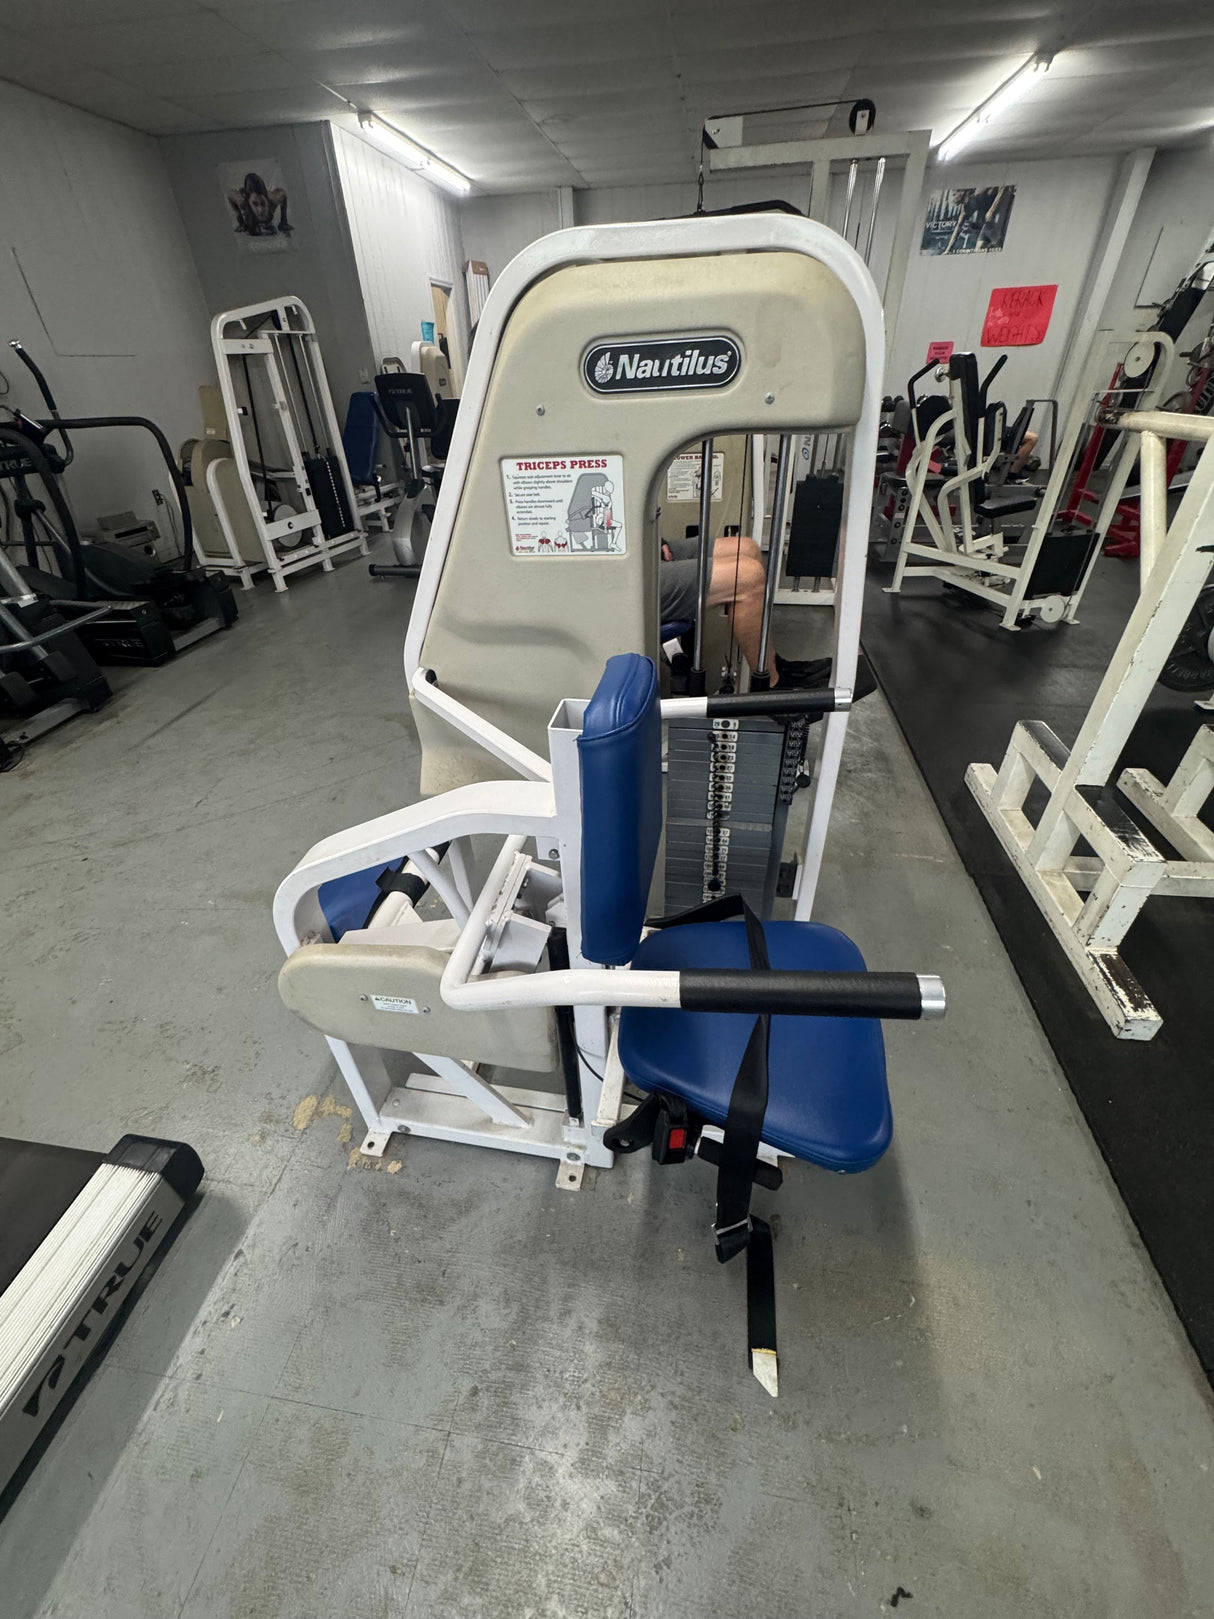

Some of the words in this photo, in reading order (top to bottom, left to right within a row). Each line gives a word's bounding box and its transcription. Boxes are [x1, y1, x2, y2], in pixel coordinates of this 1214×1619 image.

[926, 220, 958, 229] VICTORY
[615, 350, 730, 380] Nautilus
[516, 460, 567, 471] TRICEPS
[570, 459, 608, 469] PRESS
[63, 1211, 163, 1350] TRUE
